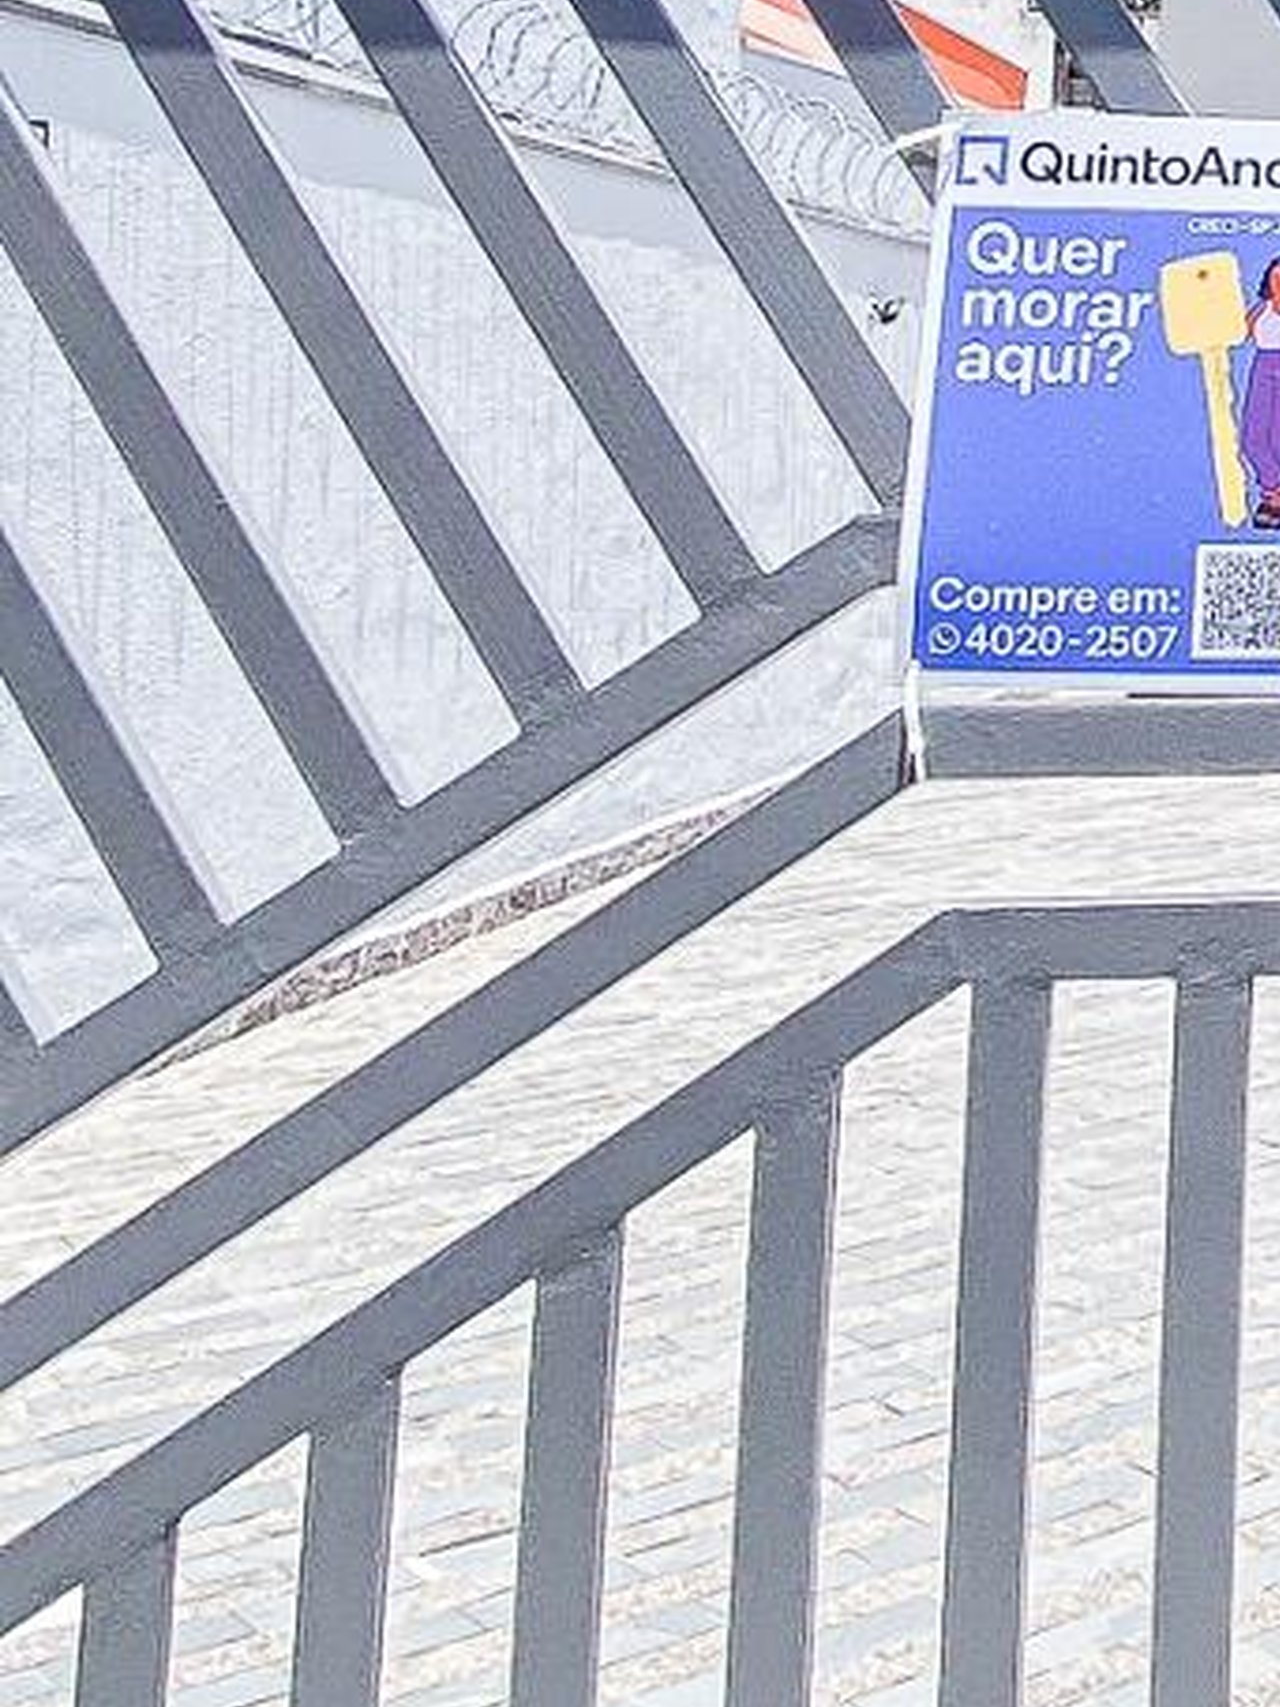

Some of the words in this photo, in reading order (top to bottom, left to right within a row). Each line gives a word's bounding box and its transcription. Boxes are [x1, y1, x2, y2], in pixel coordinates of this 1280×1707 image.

[965, 220, 1127, 277] Quer
[959, 287, 1154, 330] morar
[954, 332, 1134, 396] aqui?
[928, 576, 1100, 622] Compre
[1106, 582, 1183, 616] em:
[964, 624, 1180, 659] 4020-2507
